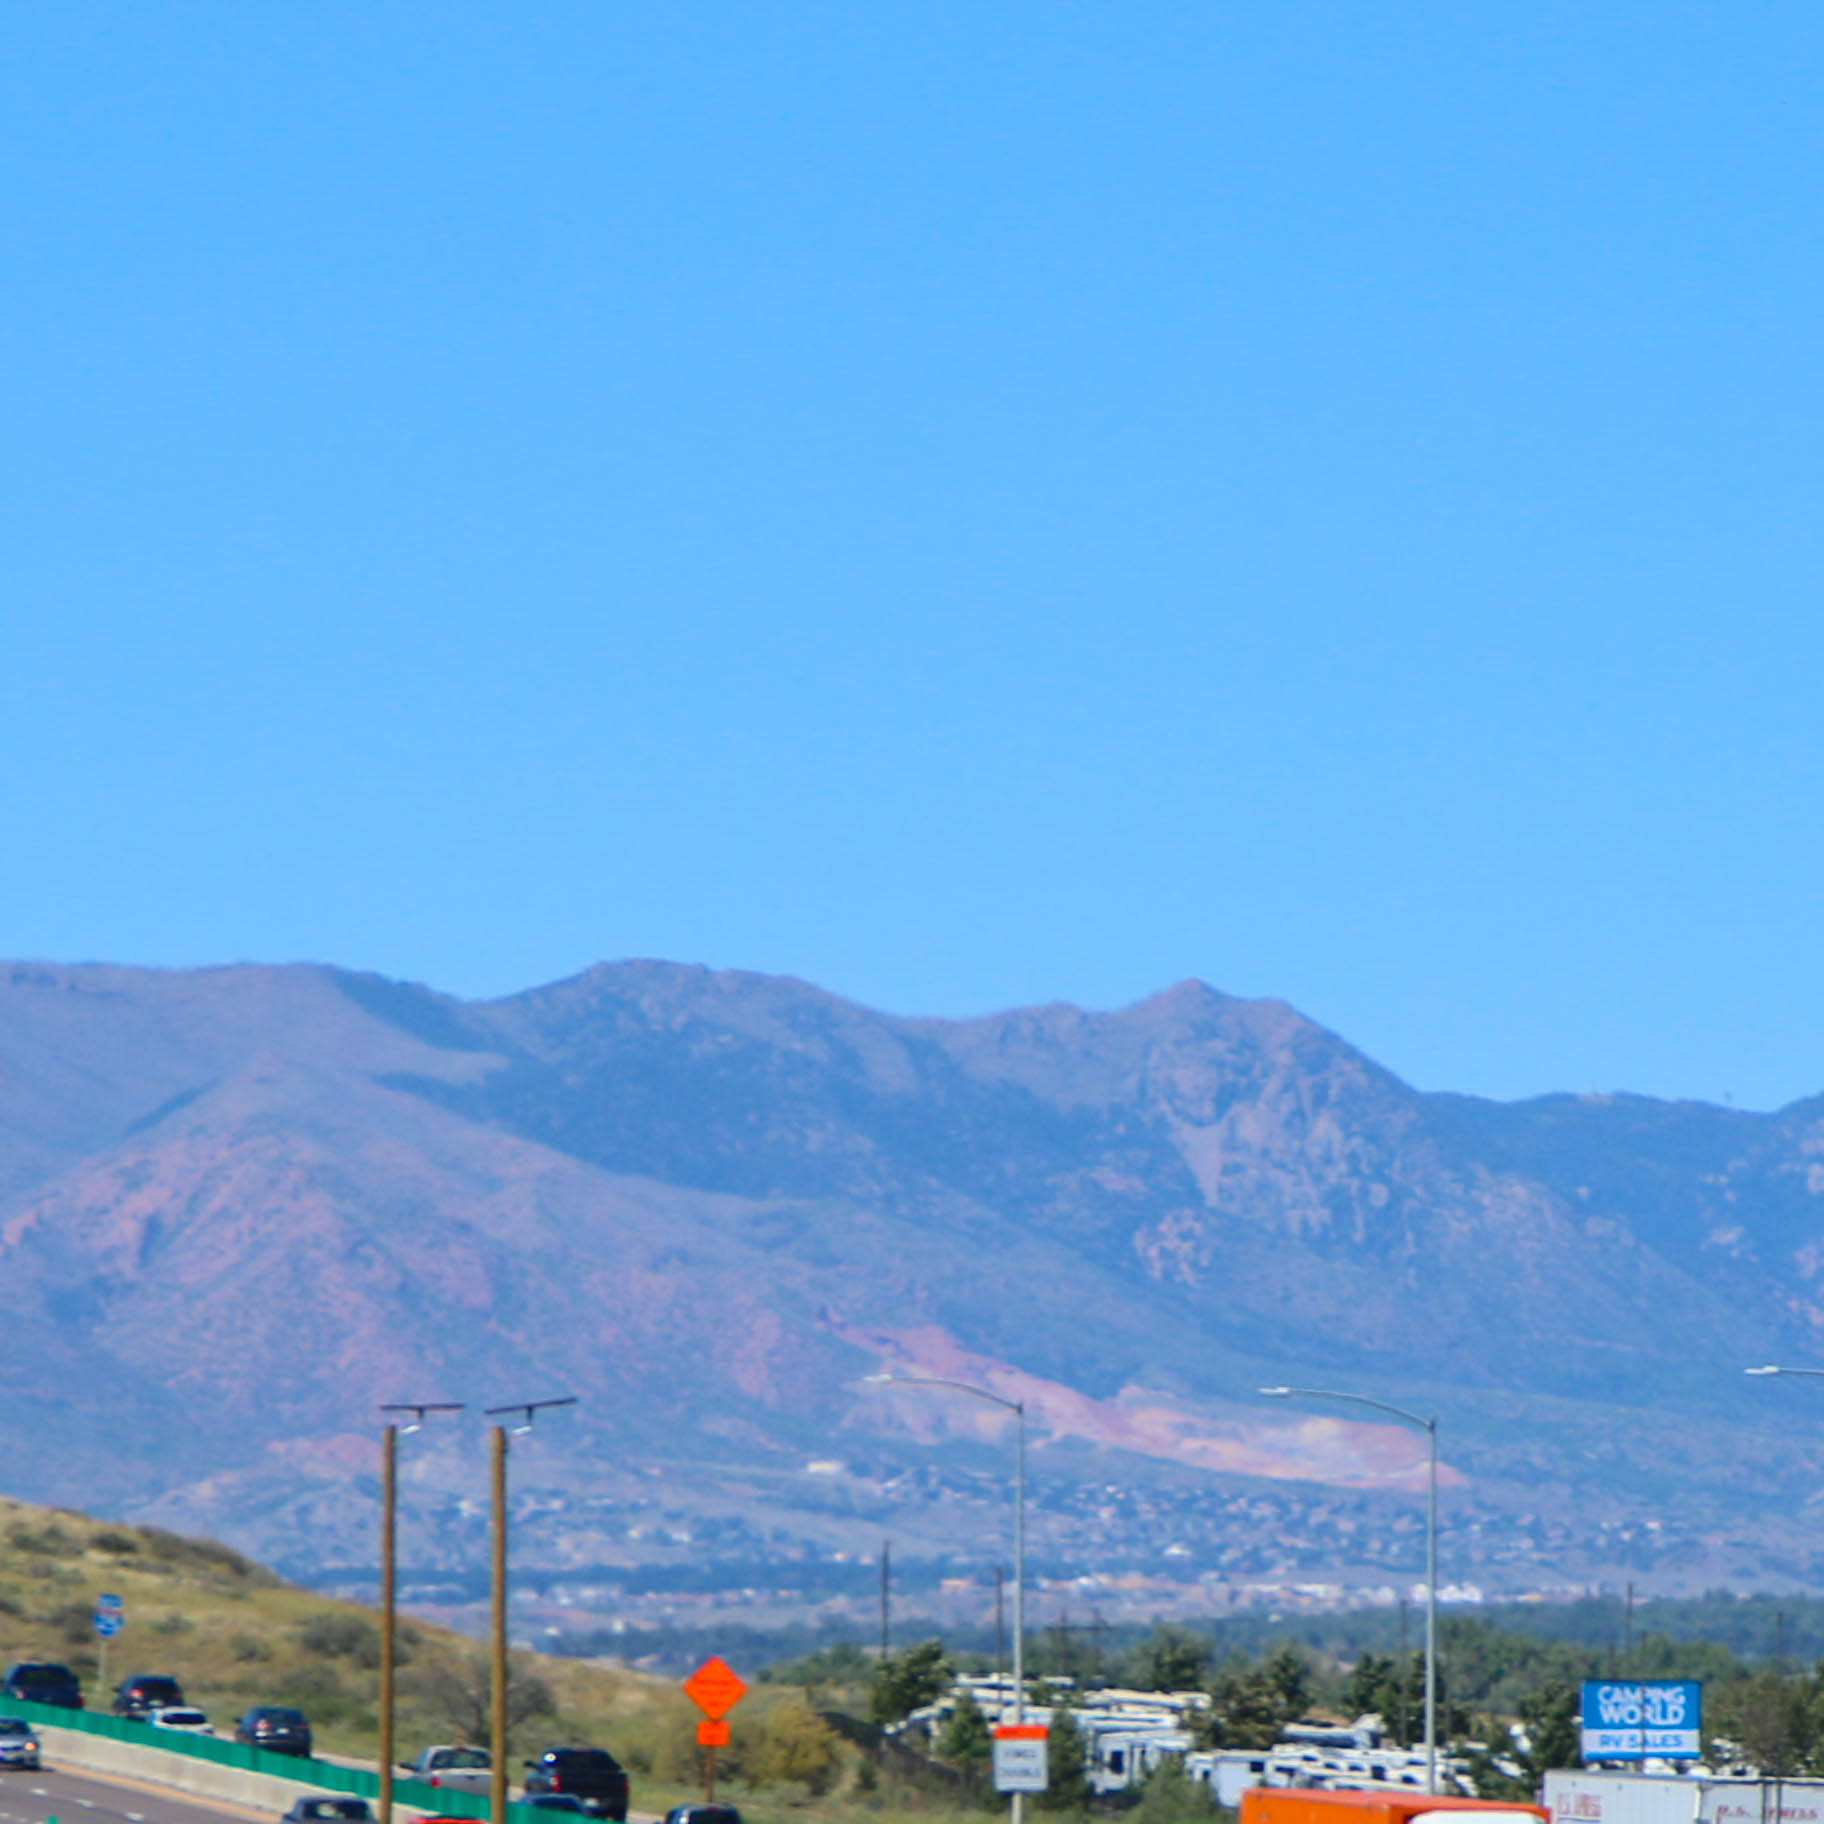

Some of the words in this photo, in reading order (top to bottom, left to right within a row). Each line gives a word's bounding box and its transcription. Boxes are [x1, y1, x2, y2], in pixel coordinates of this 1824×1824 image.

[1597, 1686, 1686, 1704] CAMPING
[1599, 1704, 1685, 1724] WORLD
[1600, 1735, 1622, 1747] RV
[1628, 1735, 1682, 1748] SALES
